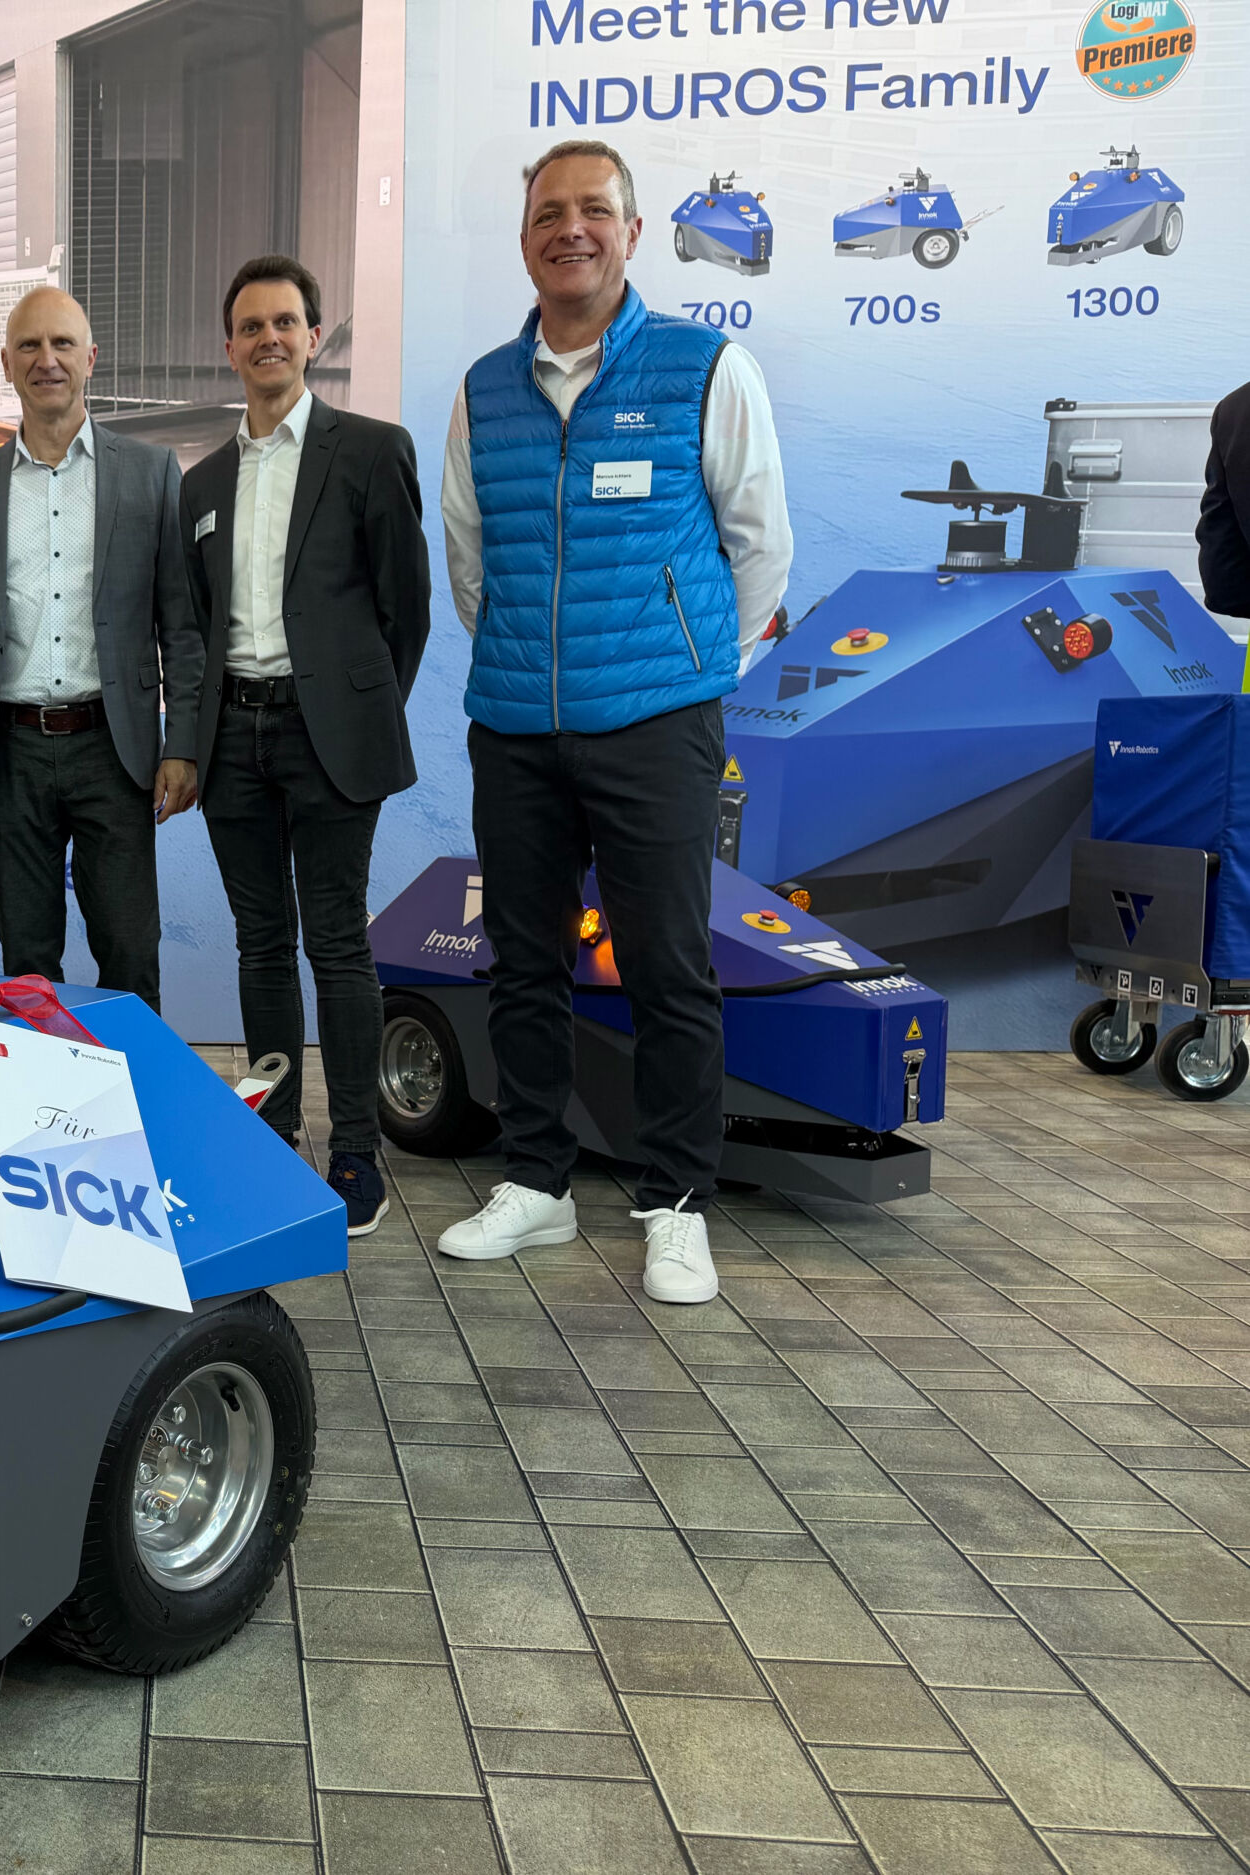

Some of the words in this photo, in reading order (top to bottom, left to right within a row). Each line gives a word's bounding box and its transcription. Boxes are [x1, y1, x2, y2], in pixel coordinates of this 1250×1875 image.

[531, 0, 688, 46] Meet
[703, 0, 805, 36] the
[824, 0, 951, 30] new
[1110, 0, 1168, 20] LogiMAT
[1083, 32, 1193, 73] Premiere
[529, 65, 827, 128] INDUROS
[844, 56, 1050, 115] Family
[680, 299, 753, 330] 700
[844, 294, 941, 326] 700s
[1066, 285, 1161, 319] 1300
[614, 412, 645, 423] SICK
[595, 486, 622, 496] SICK
[1162, 659, 1214, 685] Innok
[424, 928, 483, 953] Innok
[843, 975, 918, 993] Innok
[34, 1106, 98, 1140] Für
